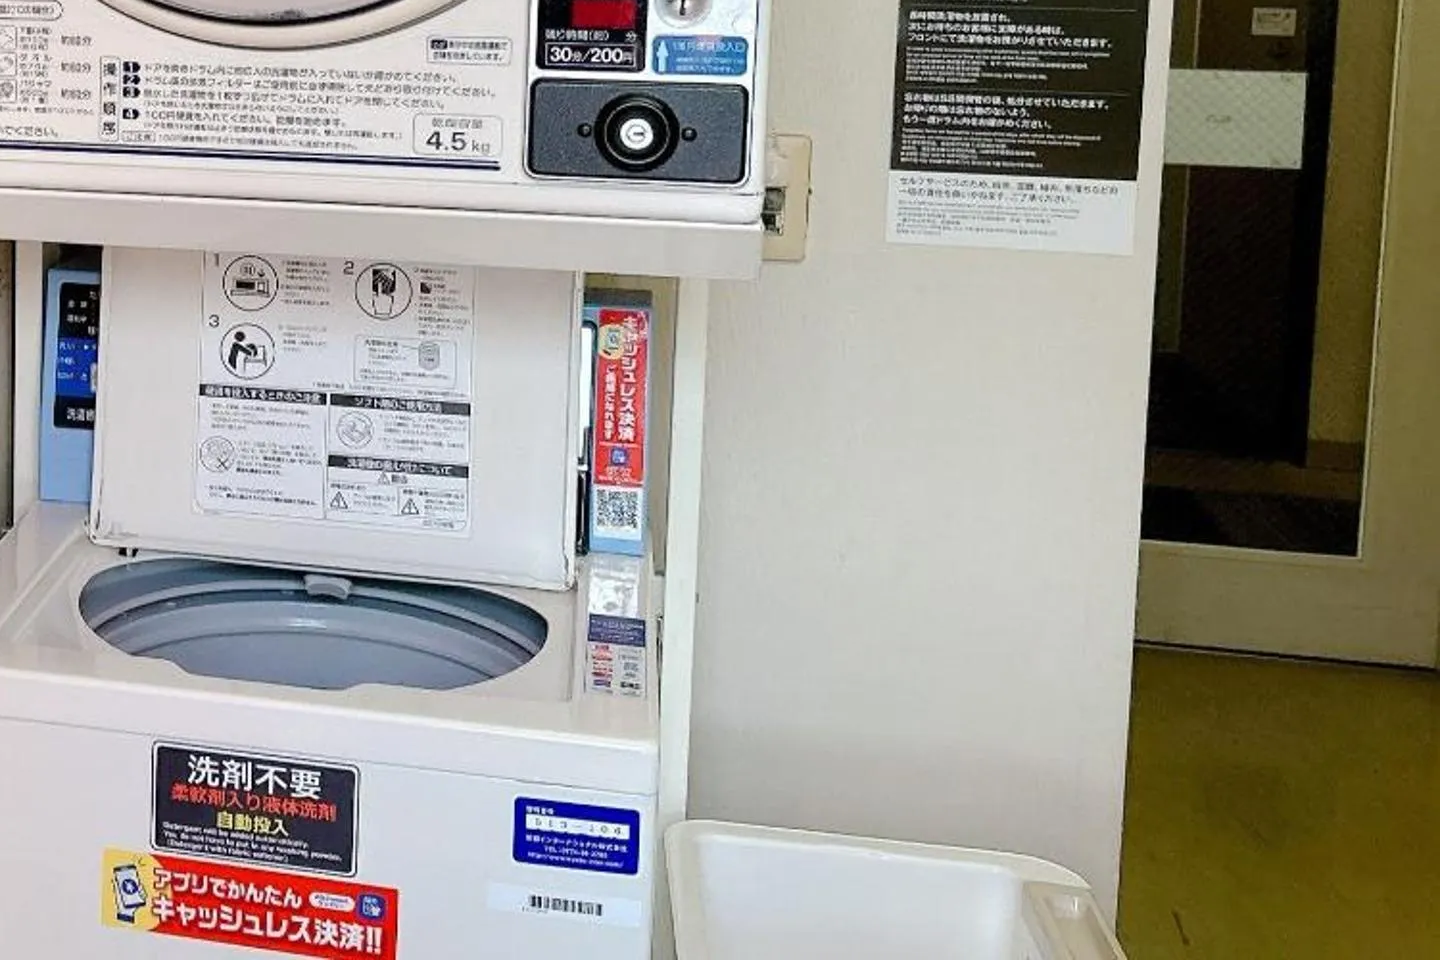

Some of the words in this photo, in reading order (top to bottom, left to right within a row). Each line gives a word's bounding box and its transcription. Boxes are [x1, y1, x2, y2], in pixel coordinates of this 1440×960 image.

[549, 45, 633, 64] 30分/200円
[425, 129, 467, 152] 4.5
[343, 261, 355, 275] 2
[209, 315, 220, 328] 3
[618, 316, 639, 442] キャッシュレス決済
[187, 754, 322, 800] 洗剤不要
[170, 782, 337, 823] 柔軟剤入り液体洗剤
[216, 810, 289, 838] 自動投入
[154, 868, 303, 907] アプリでかんたん
[153, 896, 383, 956] キャッシュレス決済!!
